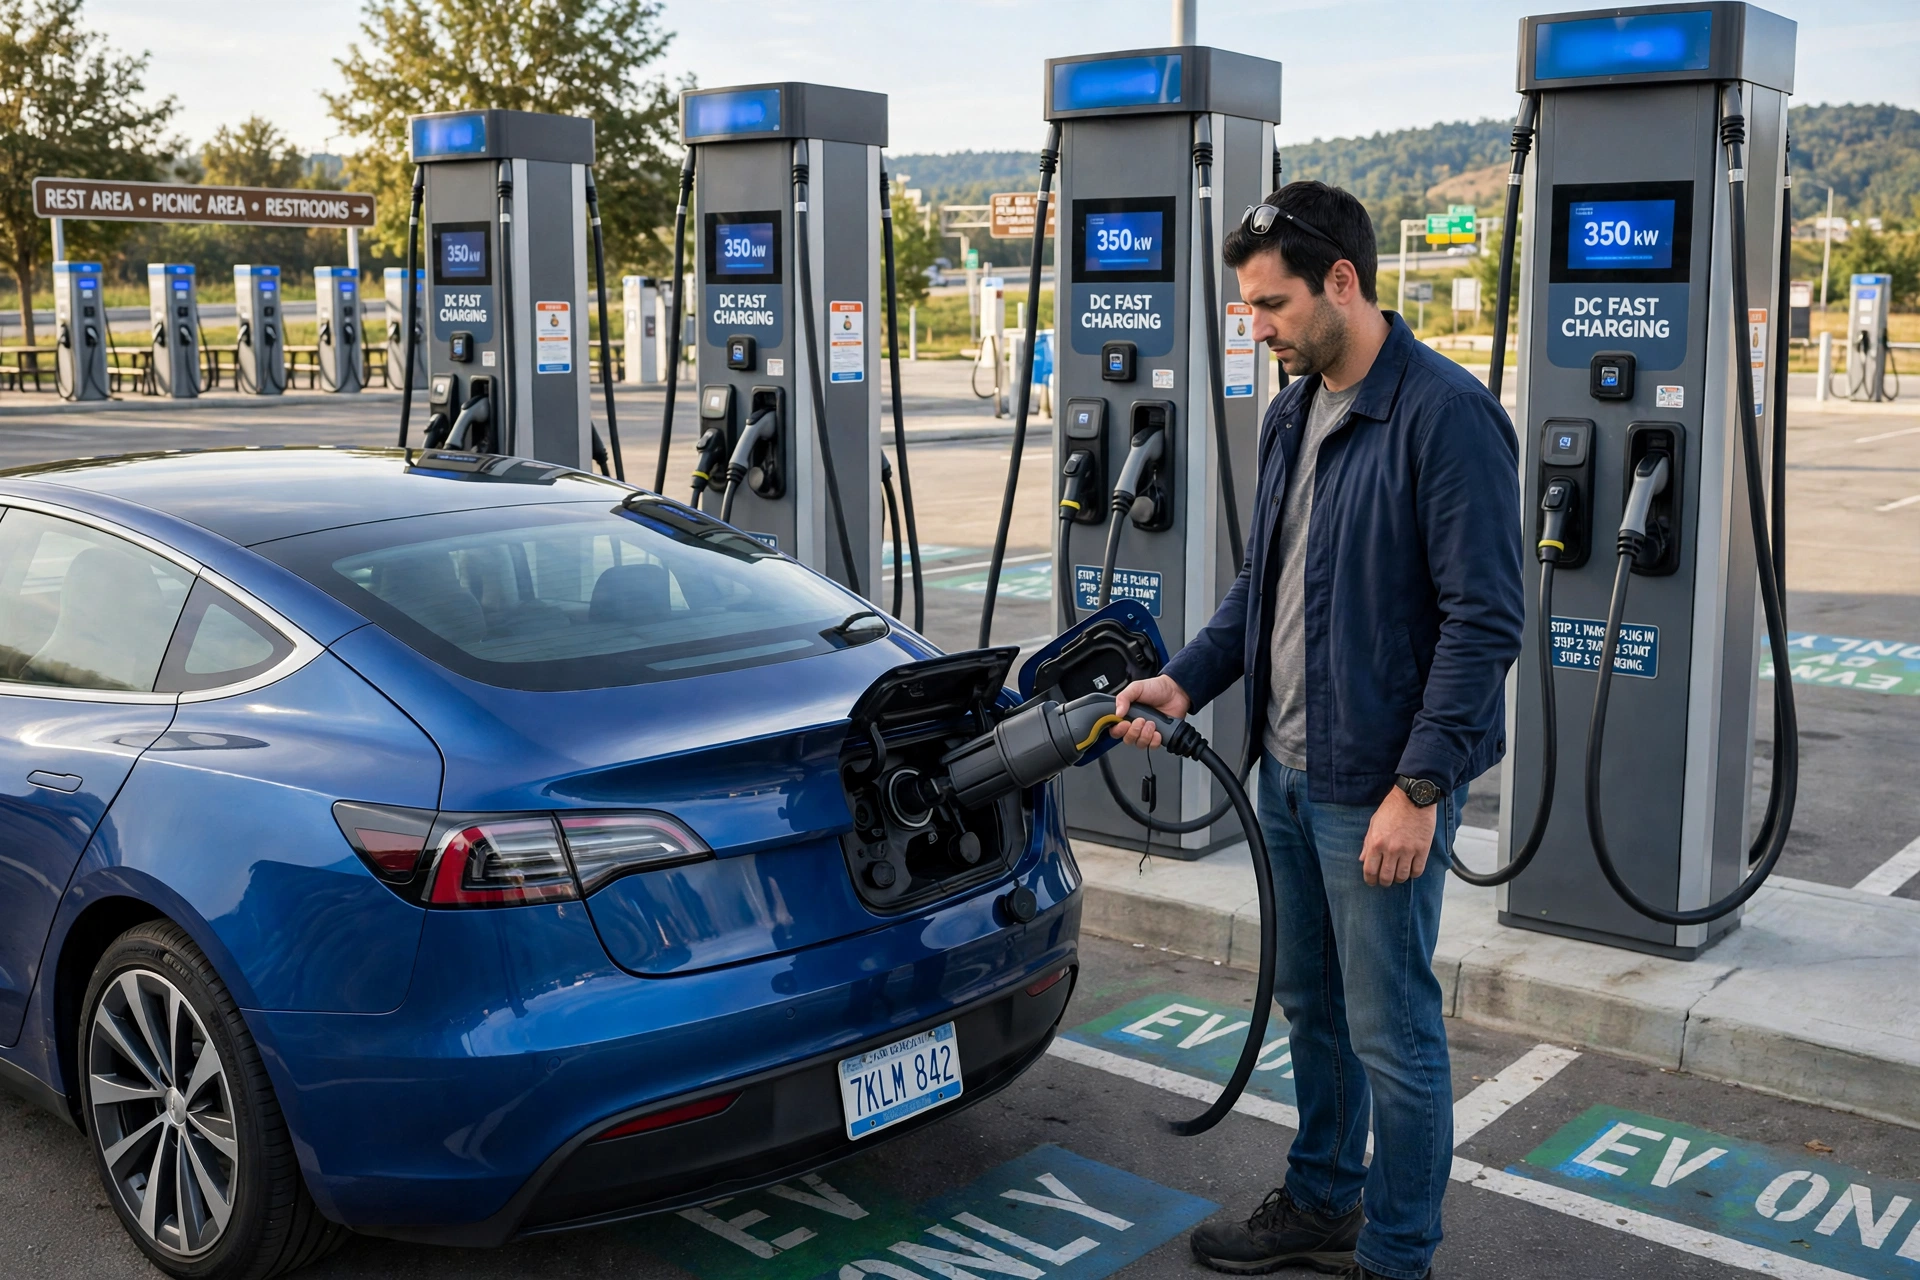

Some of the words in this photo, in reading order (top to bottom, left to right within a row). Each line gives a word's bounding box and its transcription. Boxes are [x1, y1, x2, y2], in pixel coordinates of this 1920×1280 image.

[45, 188, 86, 209] REST
[90, 190, 134, 212] AREA
[152, 193, 202, 214] PICNIC
[207, 194, 246, 216] AREA
[1097, 228, 1132, 251] 350
[1134, 236, 1152, 251] kW
[1584, 220, 1631, 246] 350
[1634, 229, 1659, 246] kW
[447, 244, 469, 262] 350
[724, 238, 751, 258] 350
[444, 294, 457, 307] DC
[458, 294, 481, 307] FAST
[719, 294, 735, 308] DC
[737, 294, 766, 308] FAST
[1090, 294, 1111, 310] DC
[1114, 294, 1152, 311] FAST
[1574, 296, 1602, 316] DC
[1608, 297, 1660, 316] FAST
[439, 308, 487, 323] CHARGING
[713, 309, 774, 325] CHARGING
[1081, 312, 1161, 329] CHARGING
[1561, 318, 1670, 339] CHARGING
[1120, 1002, 1251, 1050] EV
[850, 1061, 907, 1116] 7KLM
[914, 1045, 954, 1091] 842
[1572, 1121, 1728, 1189] EV
[1755, 1170, 1920, 1262] ON
[674, 1173, 870, 1259] EV
